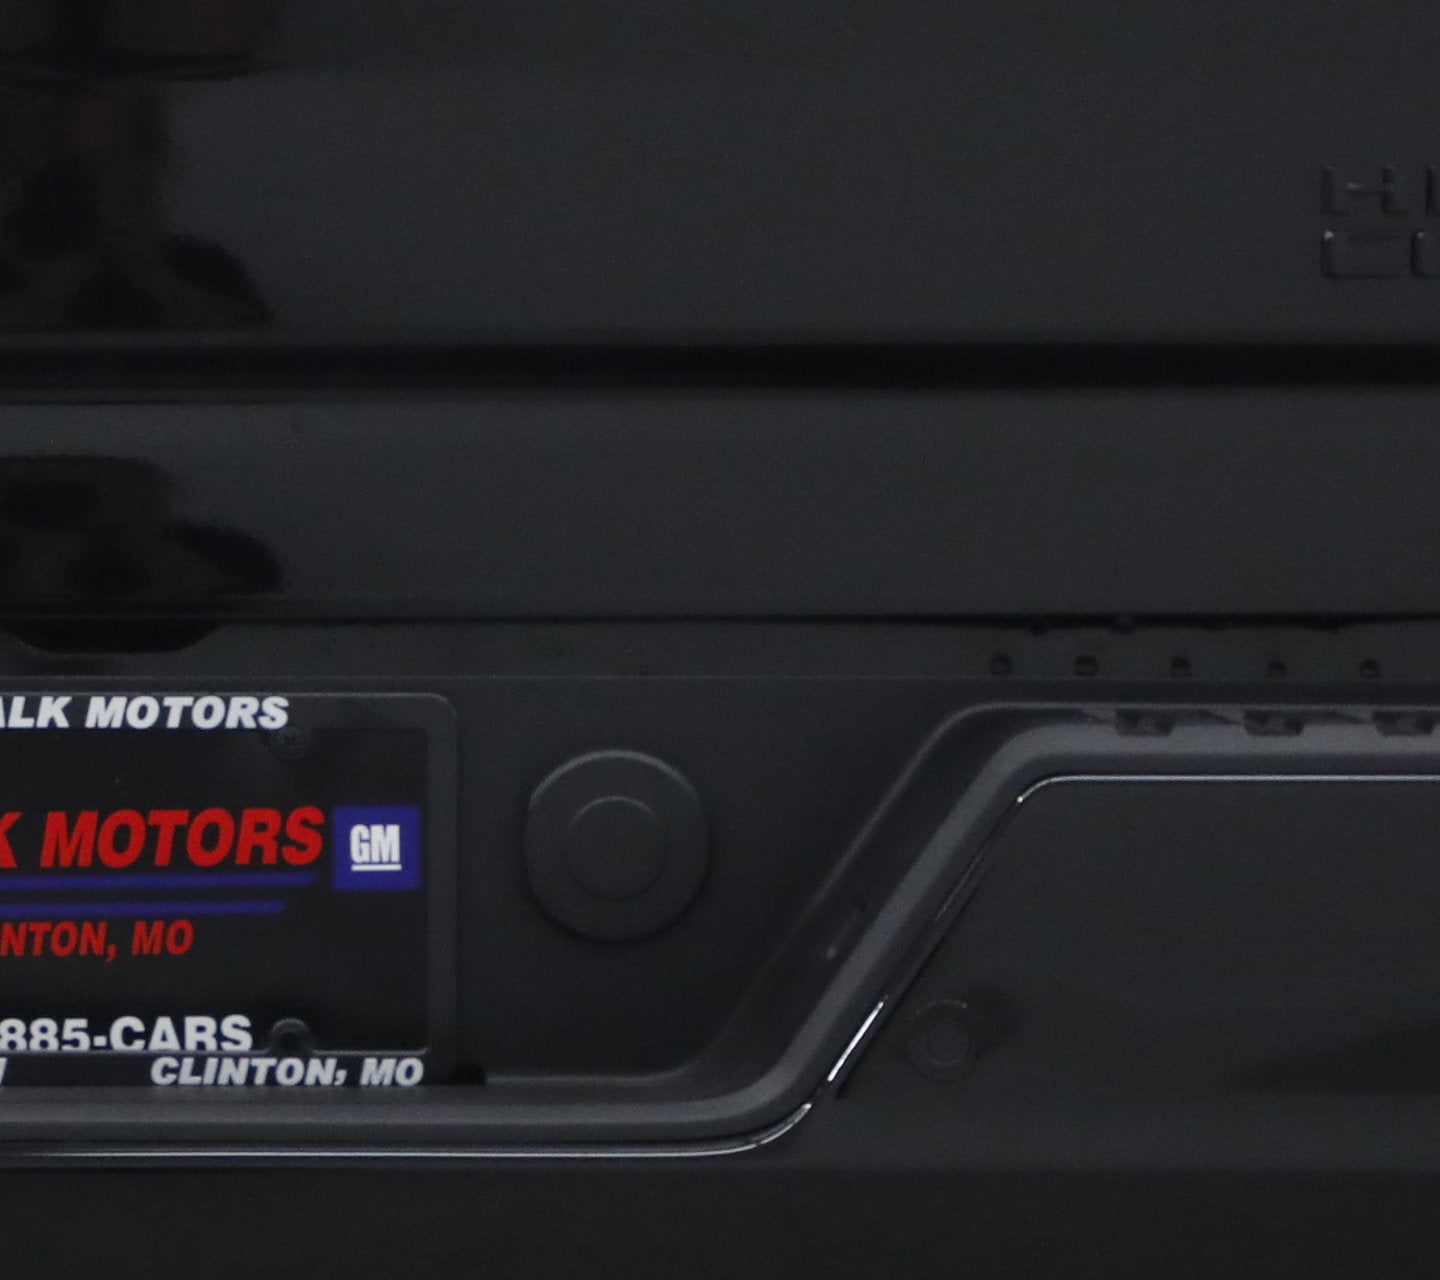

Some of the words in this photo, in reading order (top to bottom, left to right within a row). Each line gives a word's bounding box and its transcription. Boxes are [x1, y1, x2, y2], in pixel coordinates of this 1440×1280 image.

[84, 695, 290, 730] MOTORS
[38, 805, 326, 870] MOTORS
[349, 823, 403, 865] GM
[130, 919, 196, 957] MO
[149, 1056, 349, 1087] CLINTON,
[358, 1056, 426, 1087] MO
